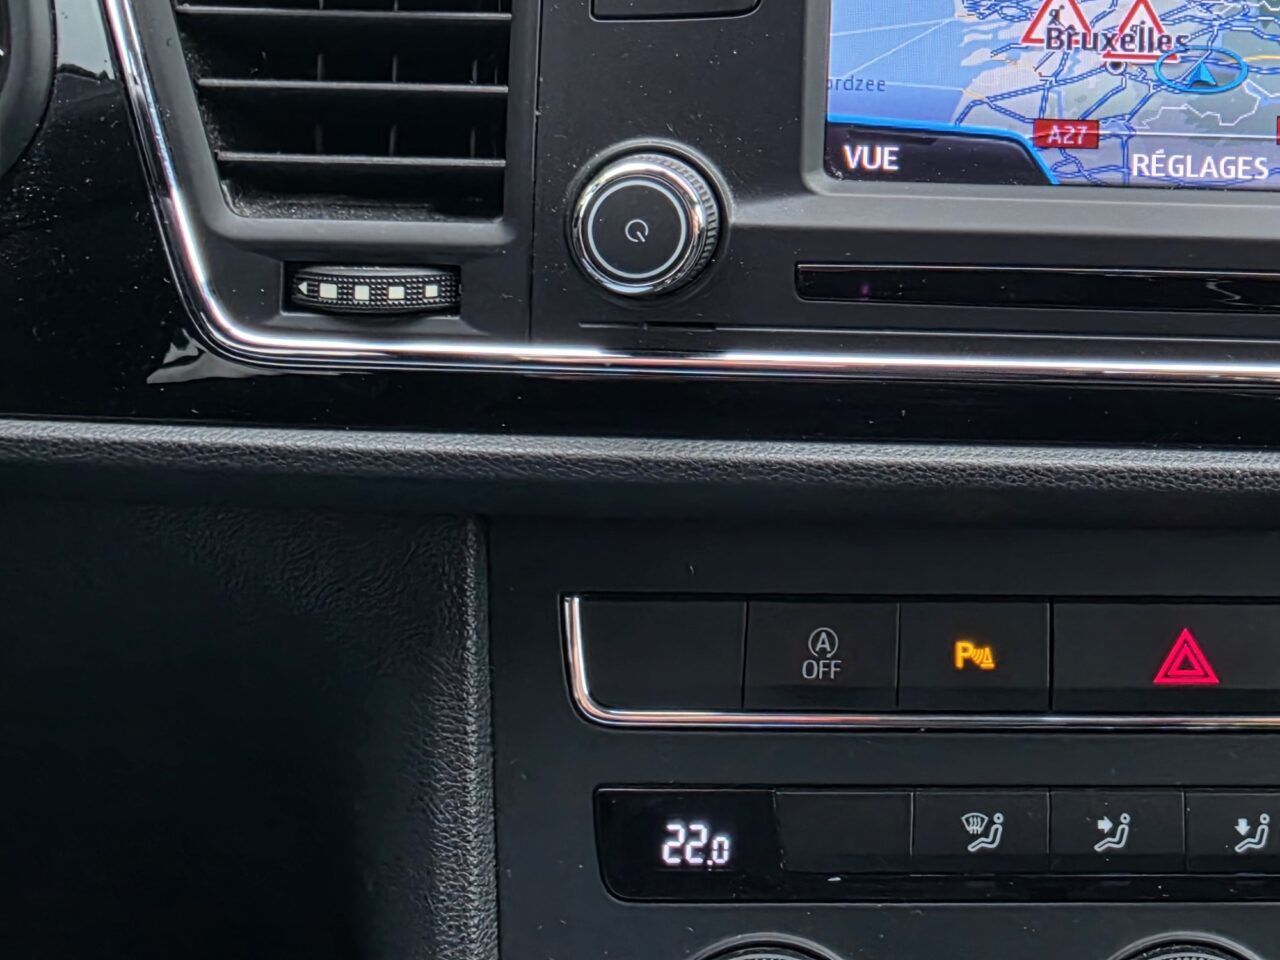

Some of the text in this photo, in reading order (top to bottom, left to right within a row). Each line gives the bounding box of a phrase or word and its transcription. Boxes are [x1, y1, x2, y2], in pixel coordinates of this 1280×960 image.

[1046, 25, 1190, 54] Bruxelles
[1047, 125, 1088, 146] A27
[843, 145, 900, 171] VUE
[1132, 148, 1270, 180] RÉGLAGES
[802, 659, 842, 680] OFF
[661, 823, 731, 867] 22.0
